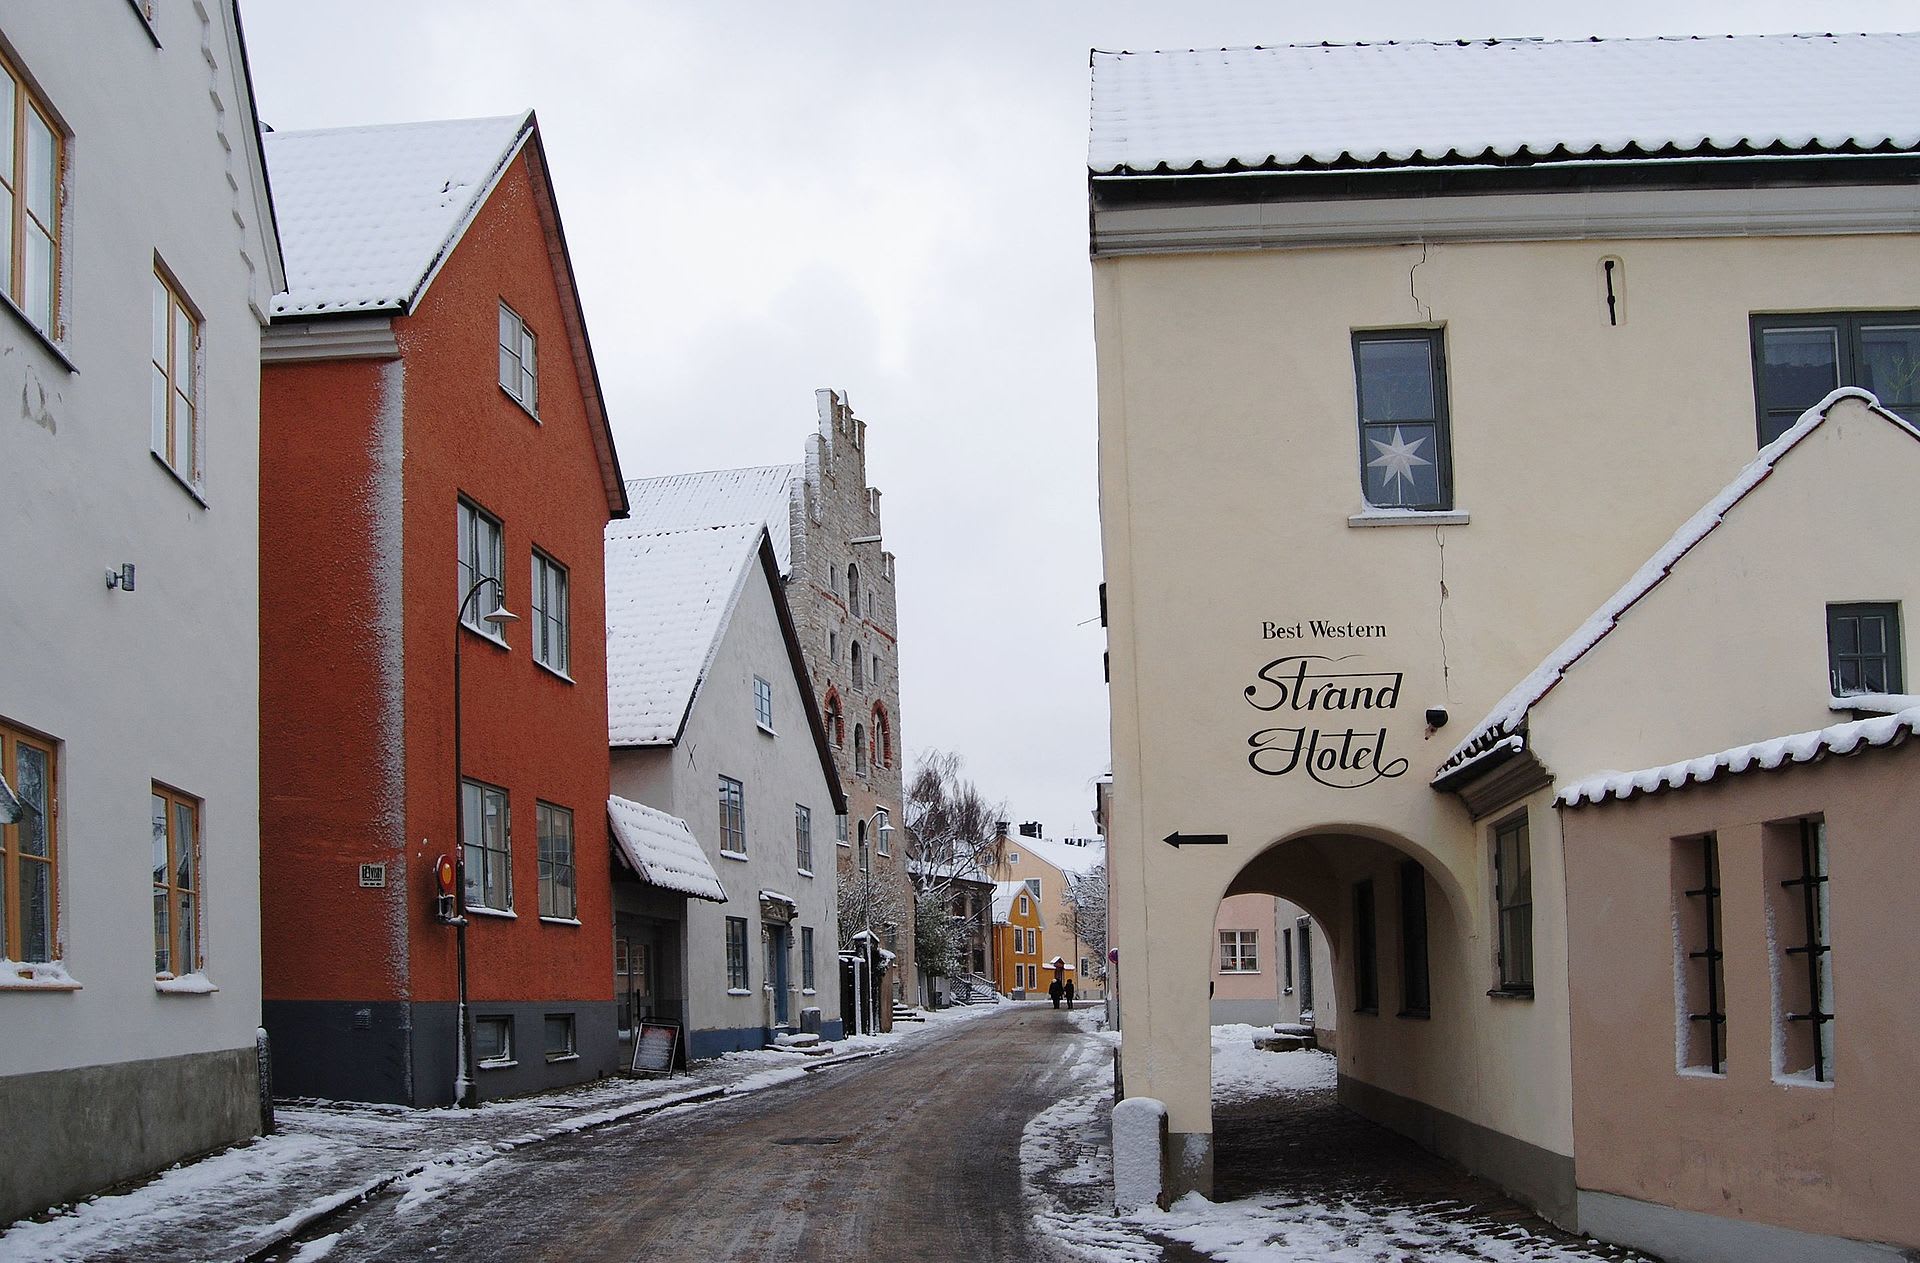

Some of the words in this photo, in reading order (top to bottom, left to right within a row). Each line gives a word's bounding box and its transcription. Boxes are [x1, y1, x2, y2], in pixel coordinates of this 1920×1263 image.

[1262, 621, 1304, 640] Best
[1309, 620, 1387, 639] Western
[1244, 654, 1403, 711] Strand
[1248, 726, 1409, 789] Hotel
